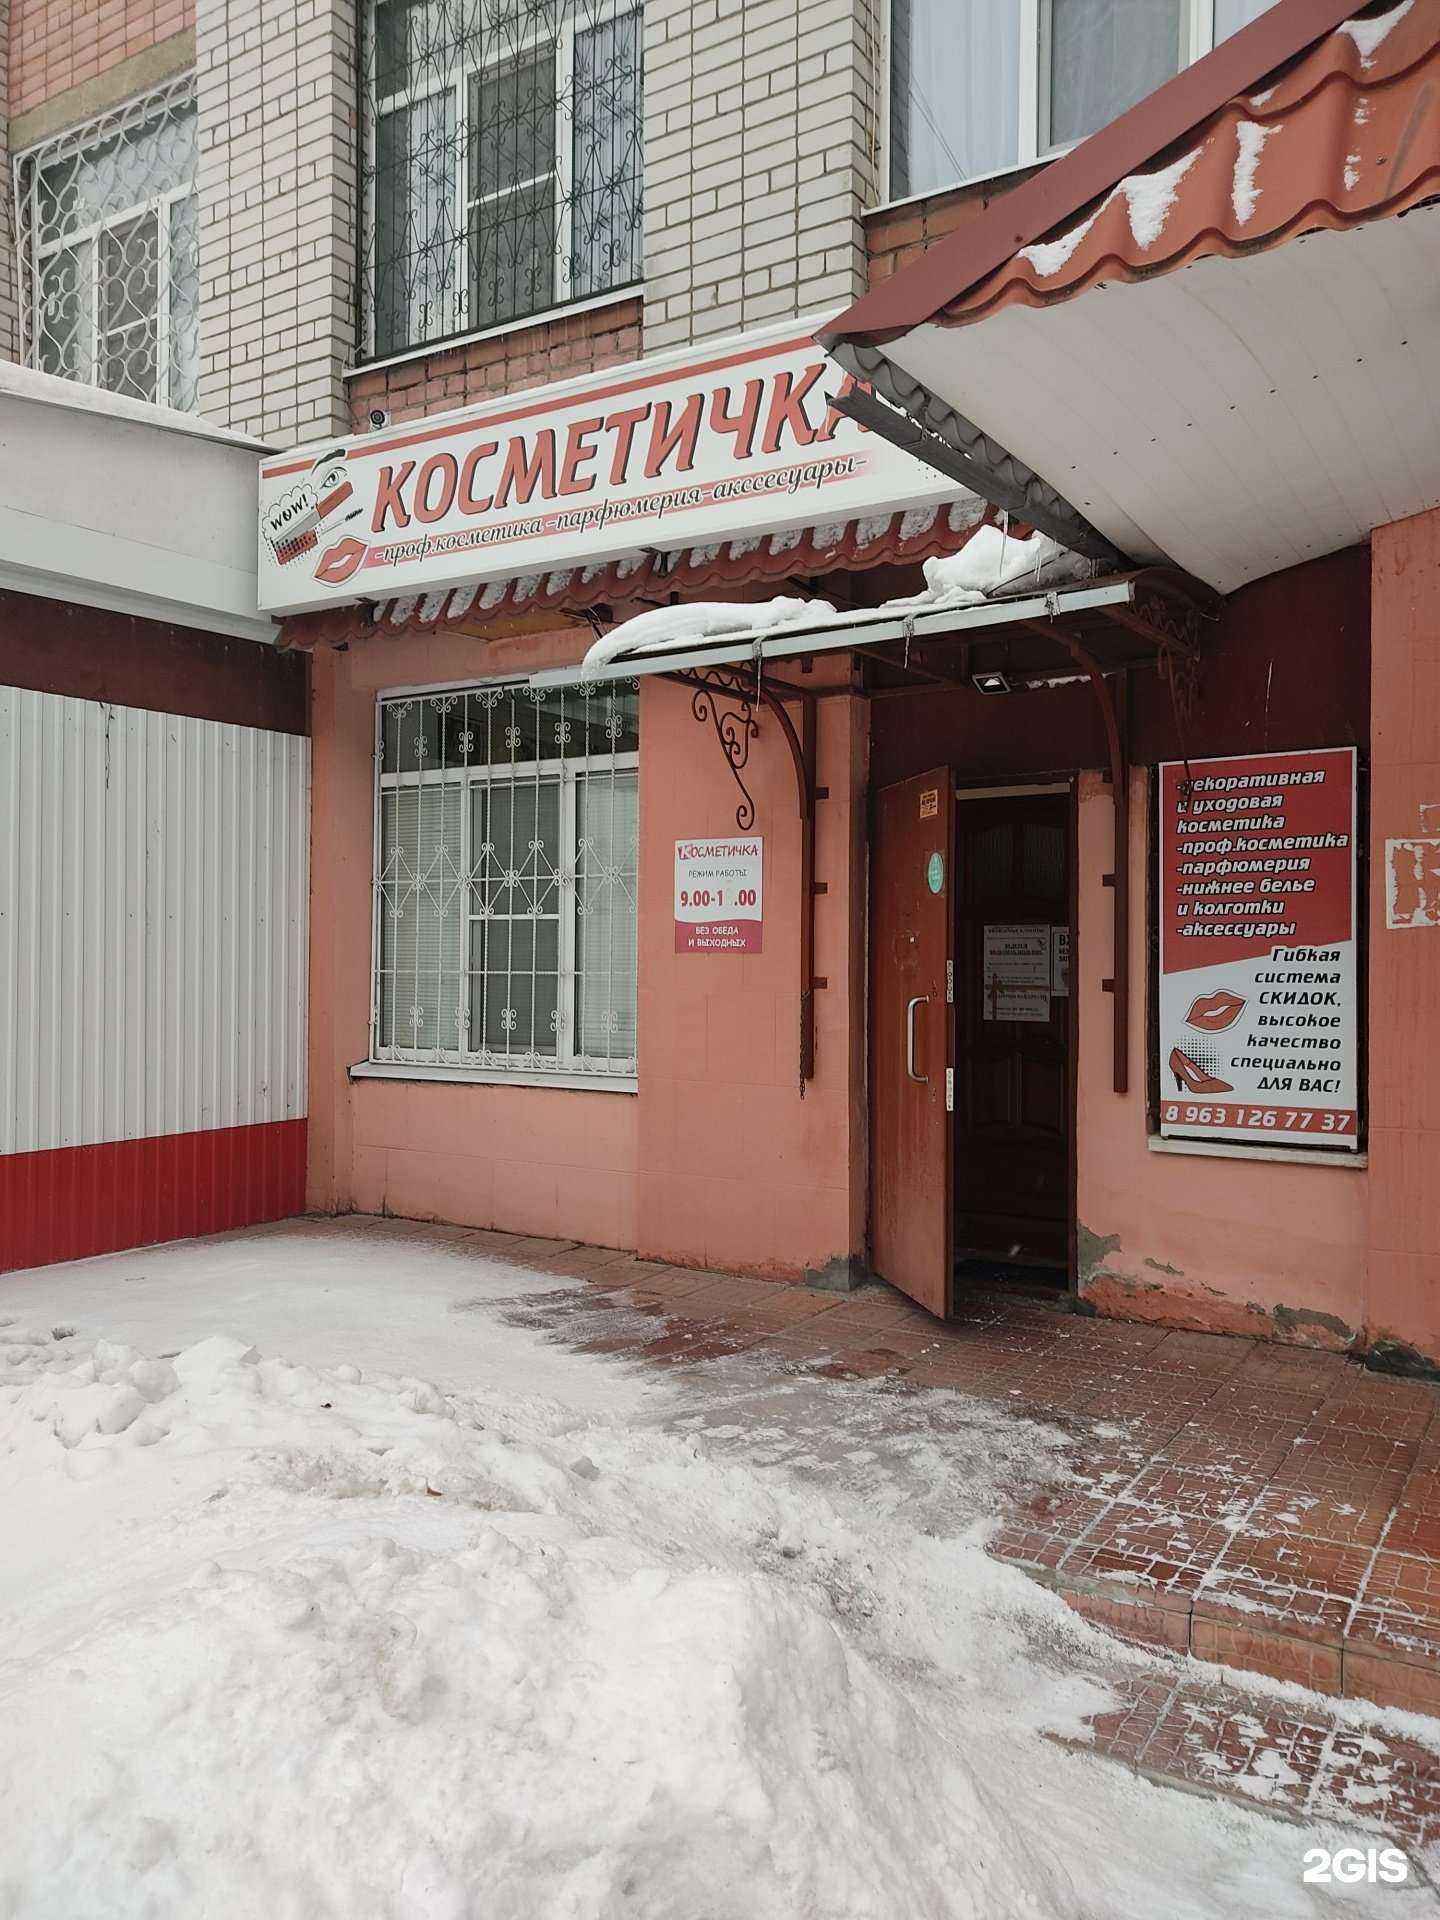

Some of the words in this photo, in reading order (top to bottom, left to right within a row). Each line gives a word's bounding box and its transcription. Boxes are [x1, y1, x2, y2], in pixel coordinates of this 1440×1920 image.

[270, 494, 309, 531] WOW!
[1192, 794, 1284, 814] уходовая
[1177, 815, 1285, 834] косметика
[1177, 832, 1349, 855] -проф.косметика
[688, 870, 714, 878] РЕЖИМ
[1177, 857, 1311, 876] -парфюмерия
[1177, 880, 1255, 895] -нижнее
[1259, 878, 1316, 893] белье
[1177, 904, 1188, 916] и
[1193, 900, 1285, 915] колготки
[695, 926, 710, 935] БЕЗ
[712, 926, 739, 935] ОБЕДА
[1177, 921, 1297, 937] -аксессуары
[688, 938, 695, 947] И
[697, 938, 747, 948] ВЫХОДНЫХ
[1272, 948, 1341, 962] Гибкая
[1254, 971, 1341, 984] система
[1259, 991, 1341, 1007] СКИДОК,
[1257, 1013, 1341, 1028] высокое
[1246, 1034, 1342, 1050] качество
[1230, 1055, 1342, 1071] специально
[1257, 1077, 1293, 1091] ДЛЯ
[1299, 1079, 1341, 1093] ВАС!
[1165, 1105, 1179, 1121] 8
[1185, 1106, 1227, 1124] 963
[1235, 1108, 1278, 1127] 126
[1283, 1112, 1313, 1129] 77
[1321, 1114, 1351, 1131] 37
